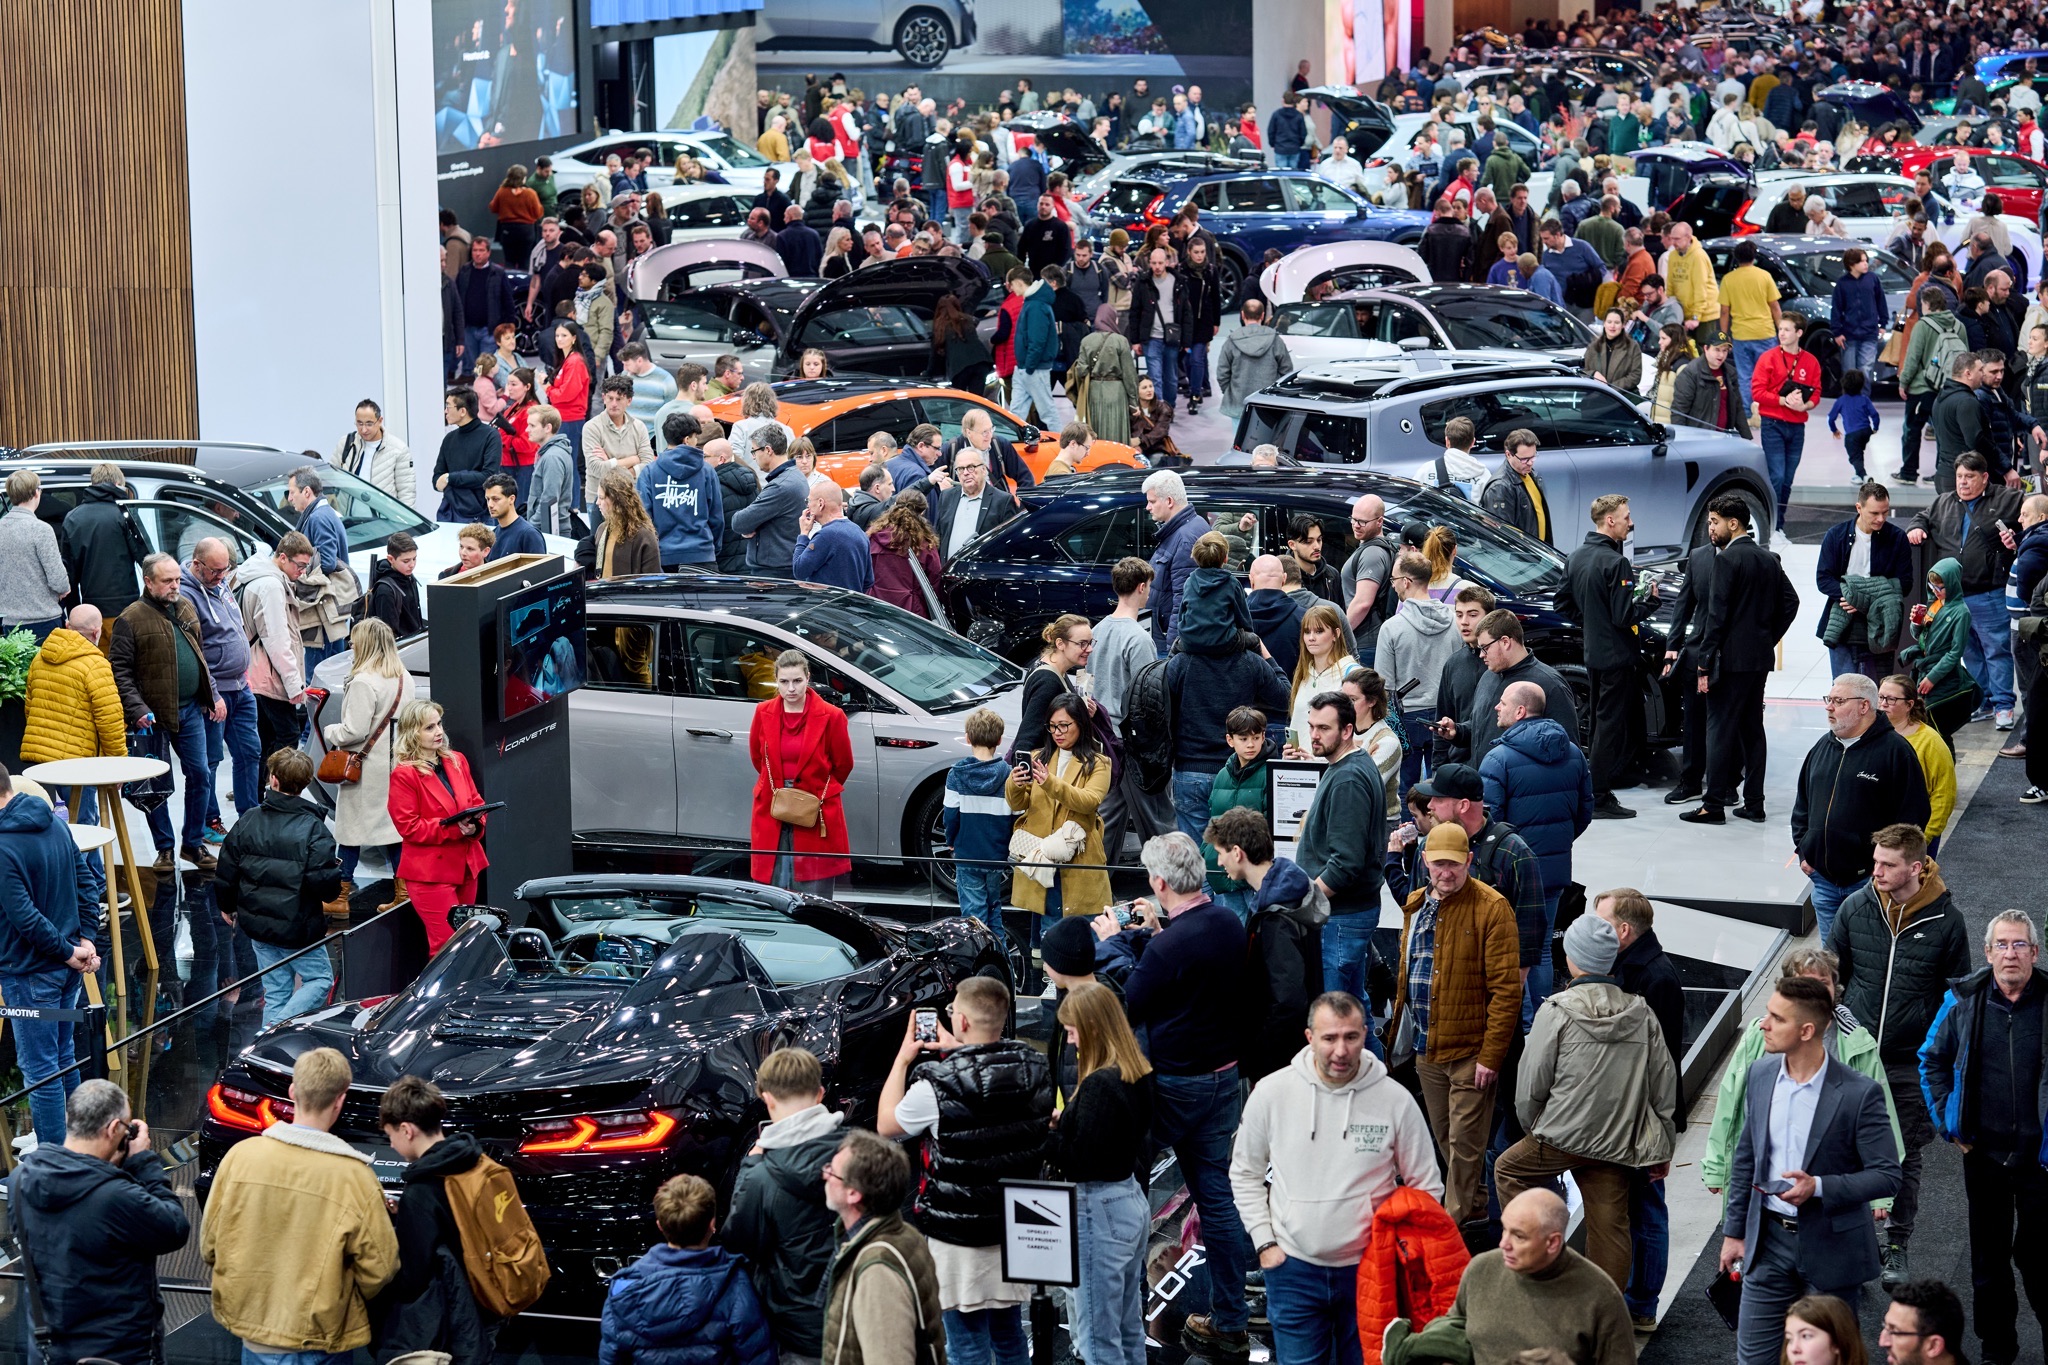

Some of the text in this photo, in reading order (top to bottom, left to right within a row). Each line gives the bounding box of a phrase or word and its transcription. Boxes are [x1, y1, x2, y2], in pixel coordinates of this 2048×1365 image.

[505, 722, 557, 752] CORVETTE
[0, 1008, 40, 1018] OMOTIVE
[1350, 1124, 1389, 1134] SUPERDRY
[373, 1160, 412, 1168] COR
